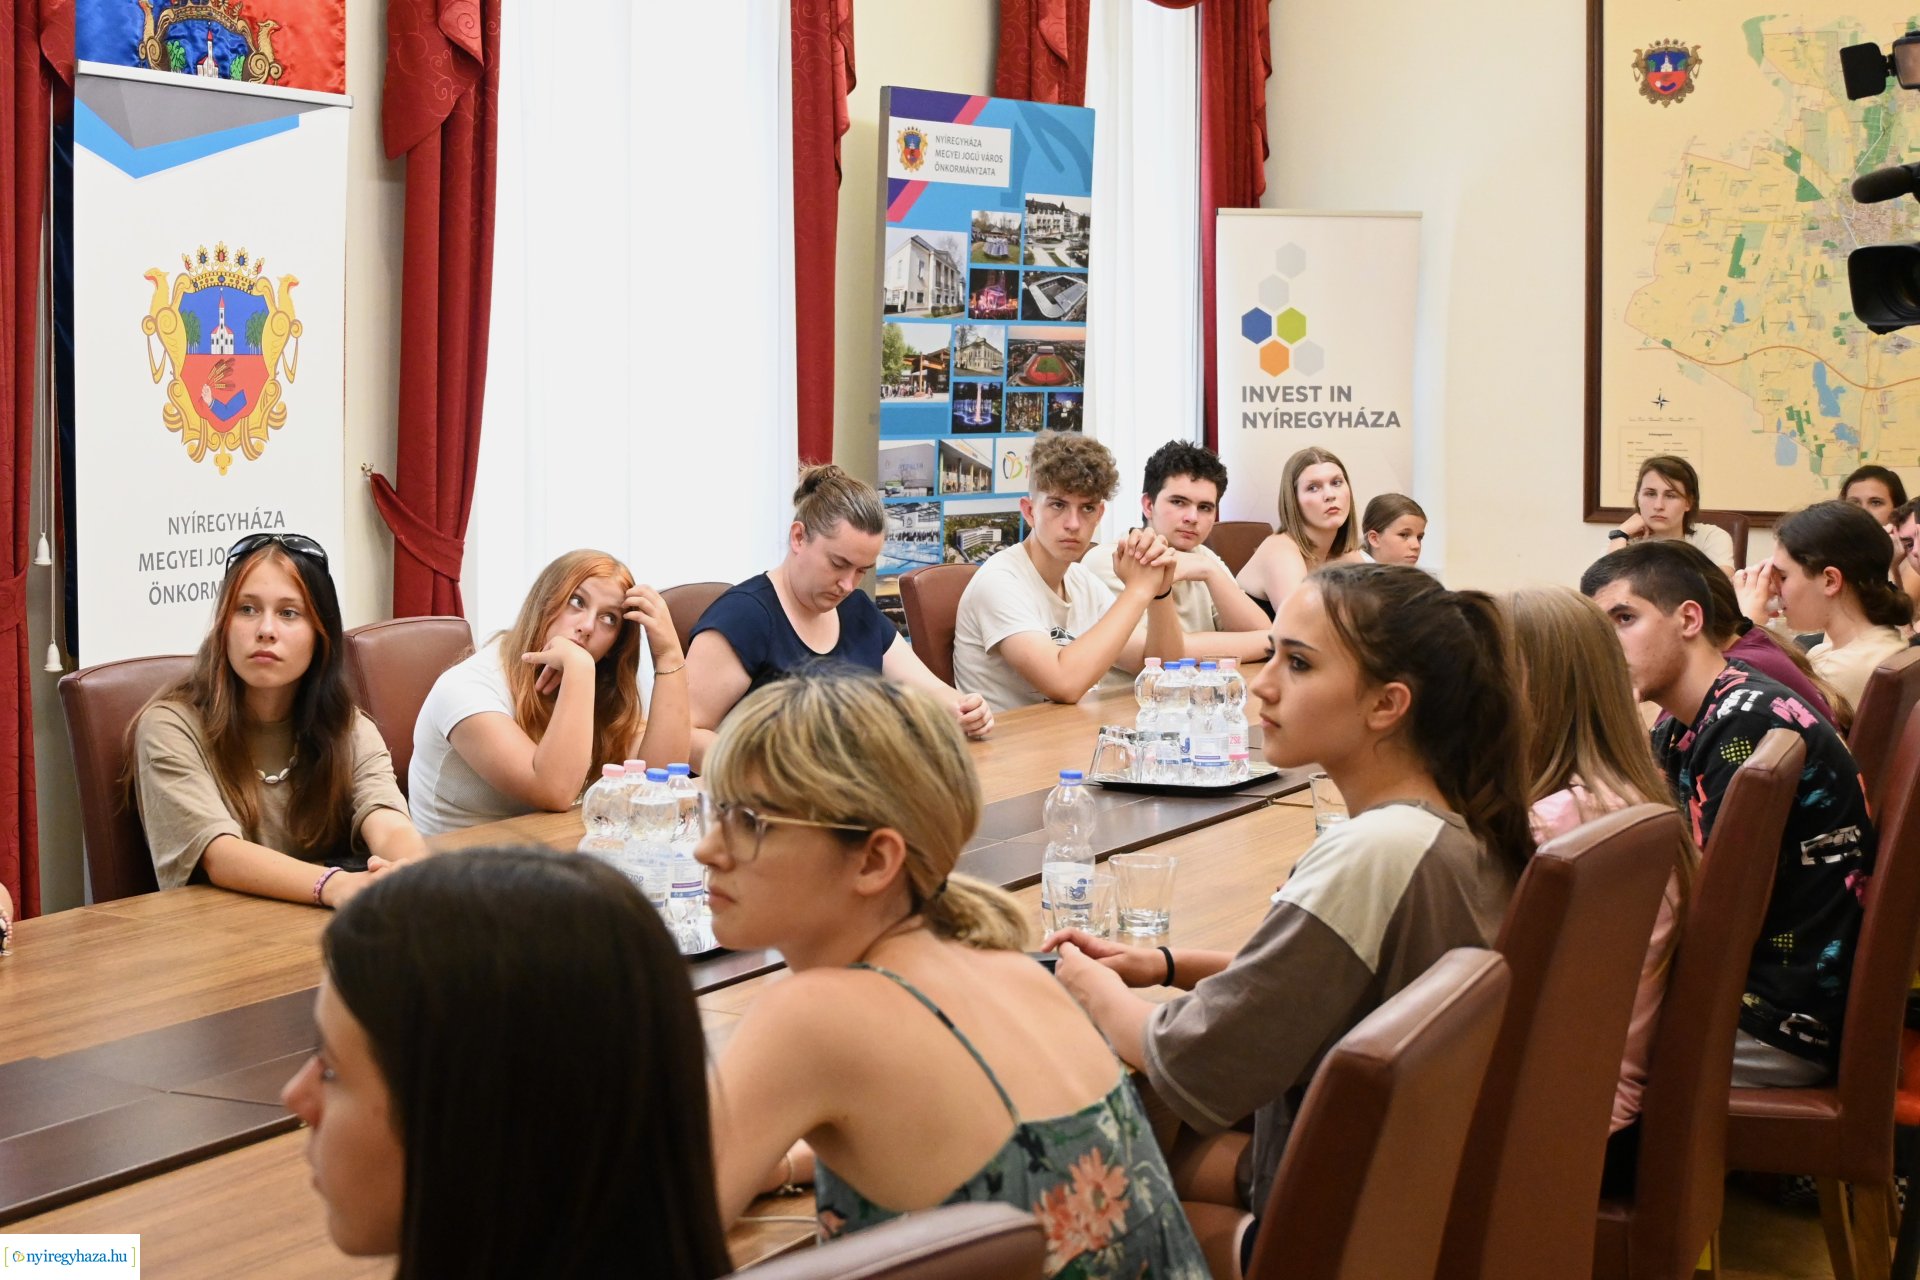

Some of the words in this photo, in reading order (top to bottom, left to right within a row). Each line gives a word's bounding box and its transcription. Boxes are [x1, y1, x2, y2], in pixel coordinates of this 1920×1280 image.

[935, 133, 982, 148] NYÍREGYHÁZA
[935, 149, 961, 160] MEGYEI
[961, 151, 980, 161] JOGÚ
[980, 152, 1003, 163] VÁROS
[934, 161, 996, 176] ÖNKORMÁNYZATA
[1241, 385, 1323, 403] INVEST
[1329, 385, 1352, 403] IN
[1241, 406, 1401, 429] NYÍREGYHÁZA
[168, 507, 285, 535] NYÍREGYHÁZA
[138, 548, 203, 572] MEGYEI
[206, 546, 226, 567] JO
